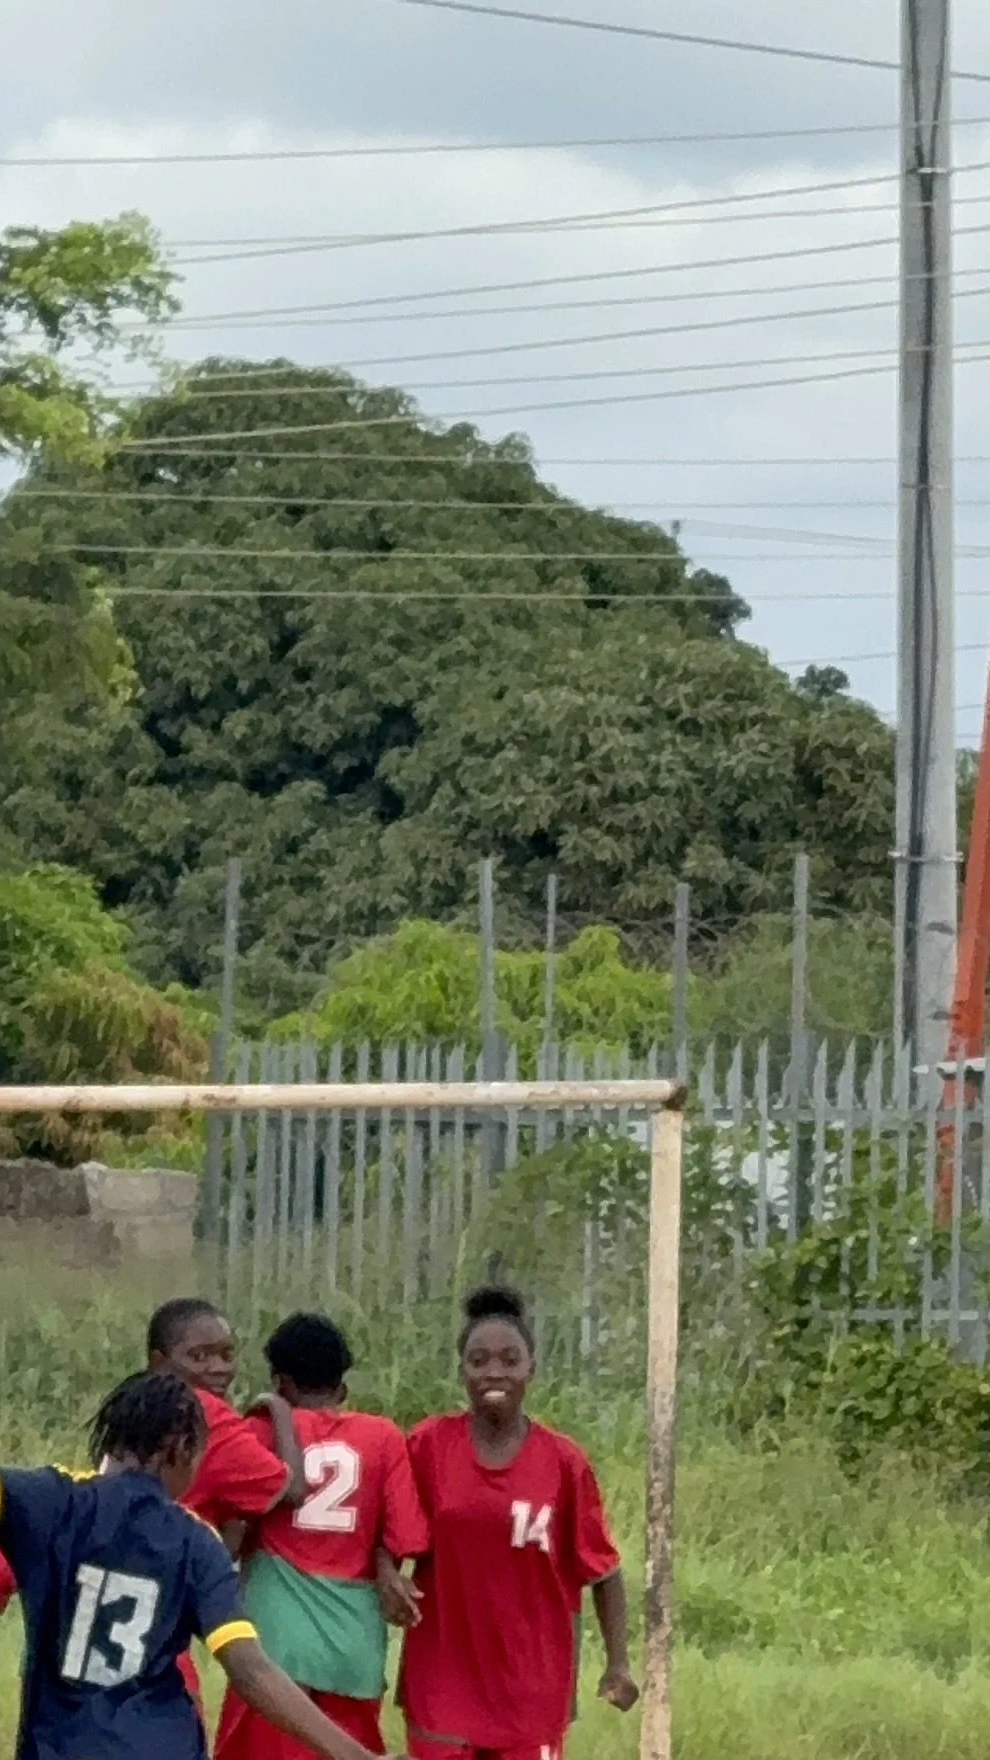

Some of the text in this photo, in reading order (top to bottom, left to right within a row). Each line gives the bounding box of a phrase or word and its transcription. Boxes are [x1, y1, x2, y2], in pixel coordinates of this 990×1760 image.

[292, 1440, 360, 1532] 2
[511, 1499, 552, 1552] 14
[61, 1563, 160, 1687] 13
